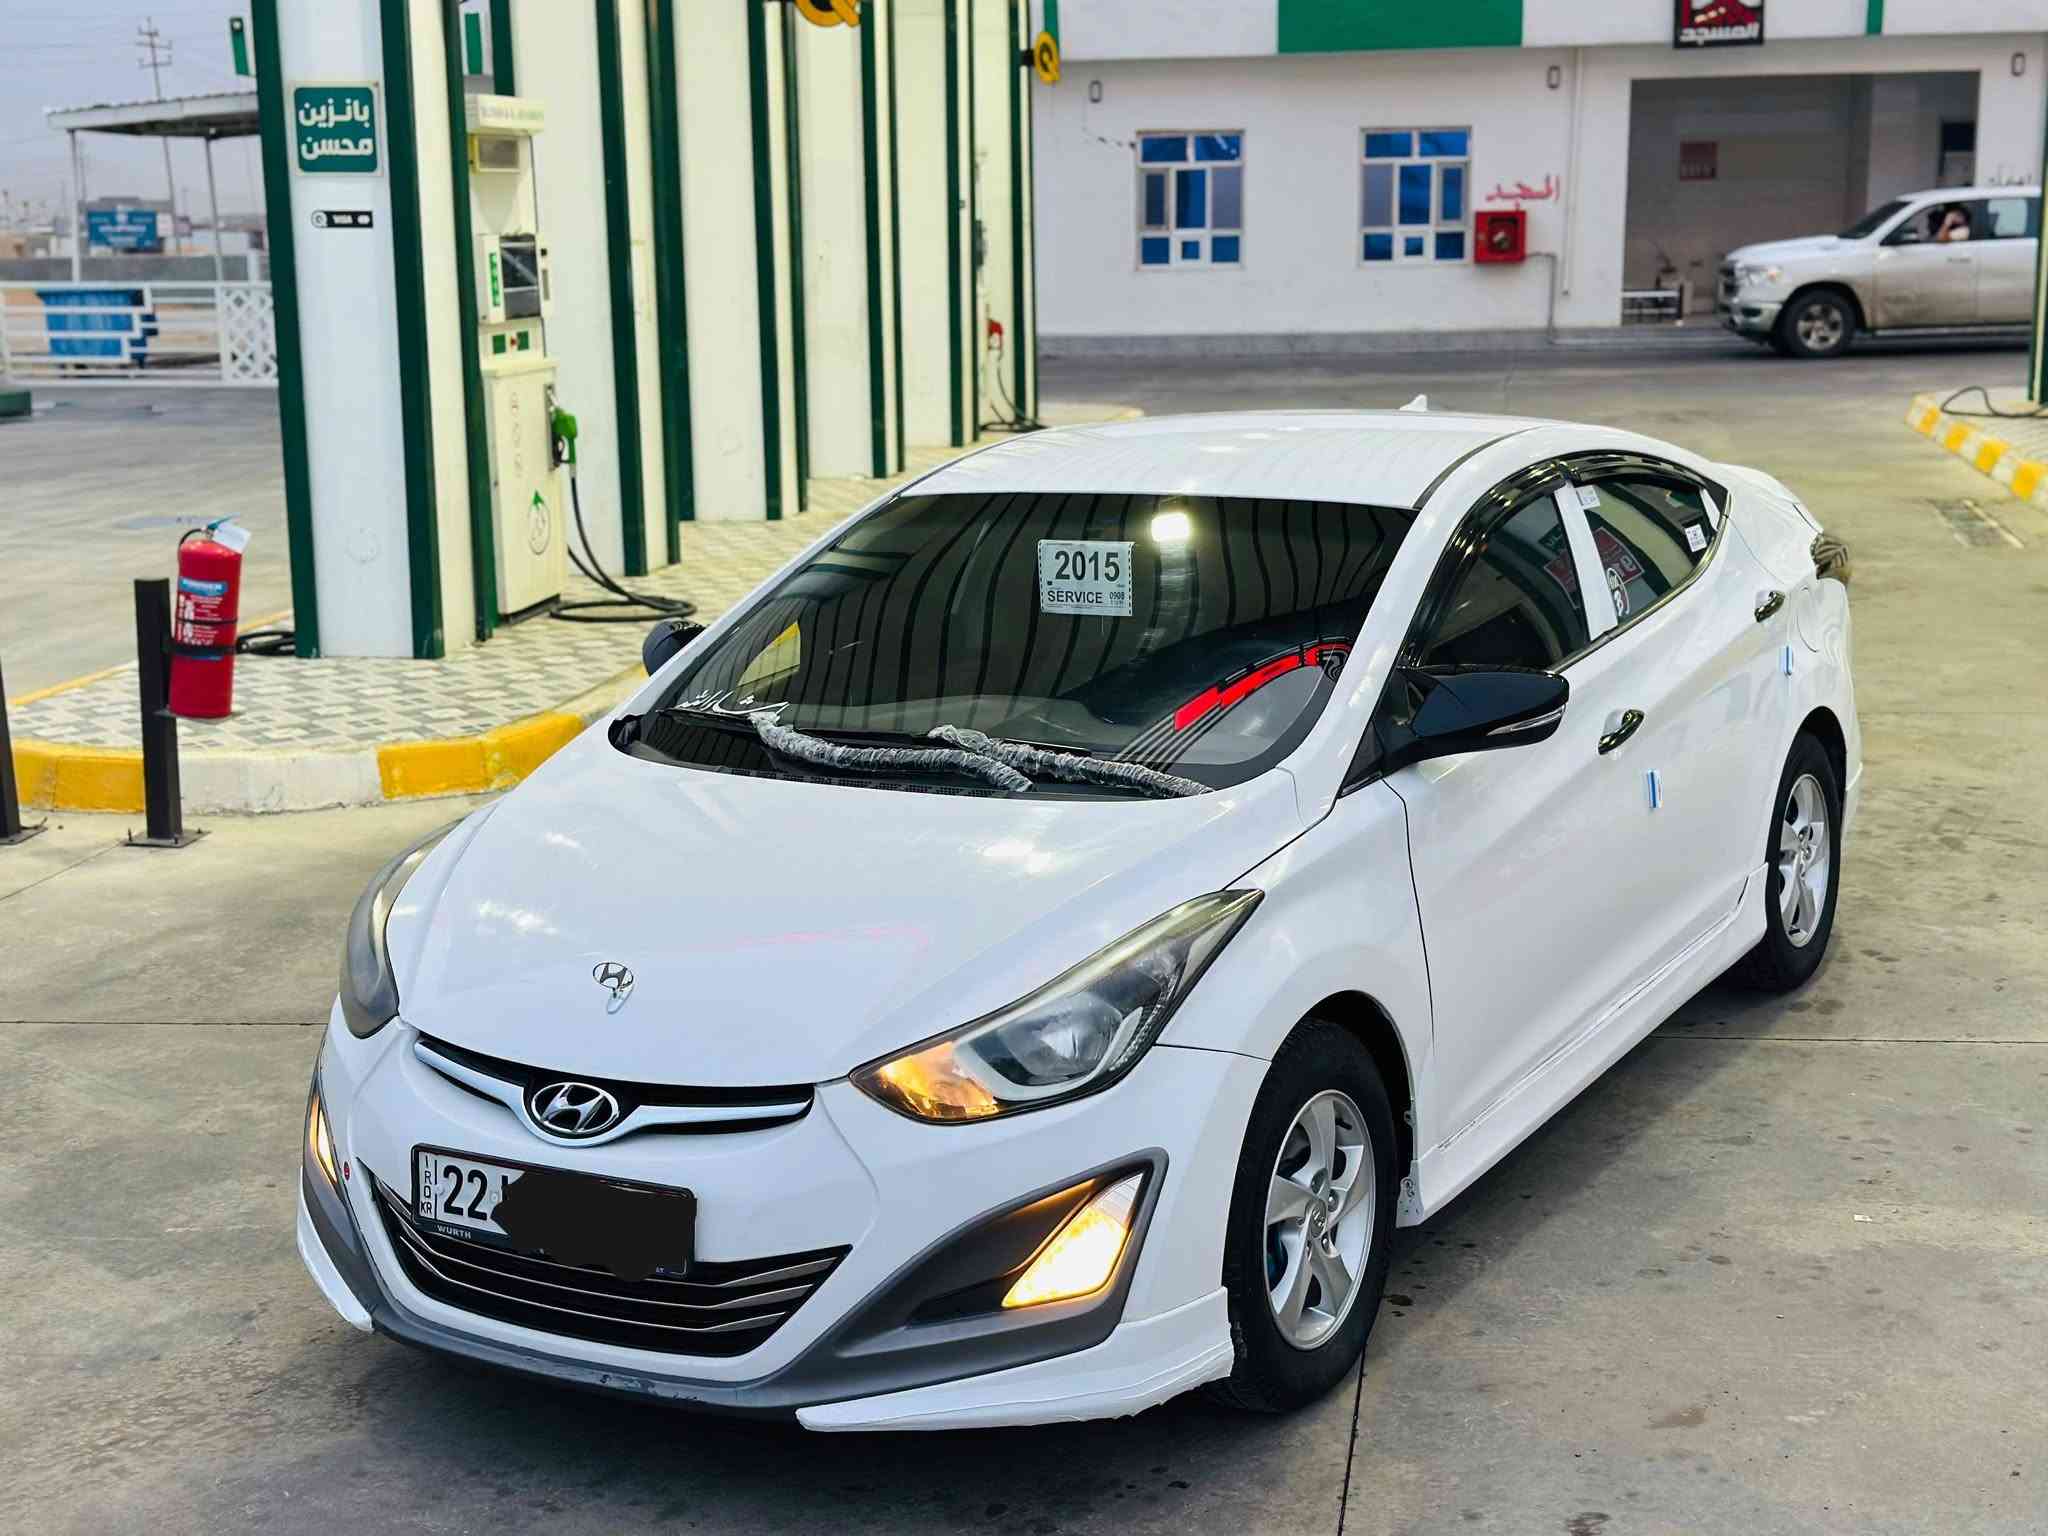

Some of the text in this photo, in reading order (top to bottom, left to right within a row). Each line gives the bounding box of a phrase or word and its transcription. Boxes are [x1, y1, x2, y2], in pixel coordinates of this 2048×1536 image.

[299, 98, 370, 127] بانزين
[301, 136, 374, 160] محسن
[1055, 550, 1119, 582] 2015
[1047, 590, 1103, 604] SERVICE
[443, 1165, 487, 1221] 22
